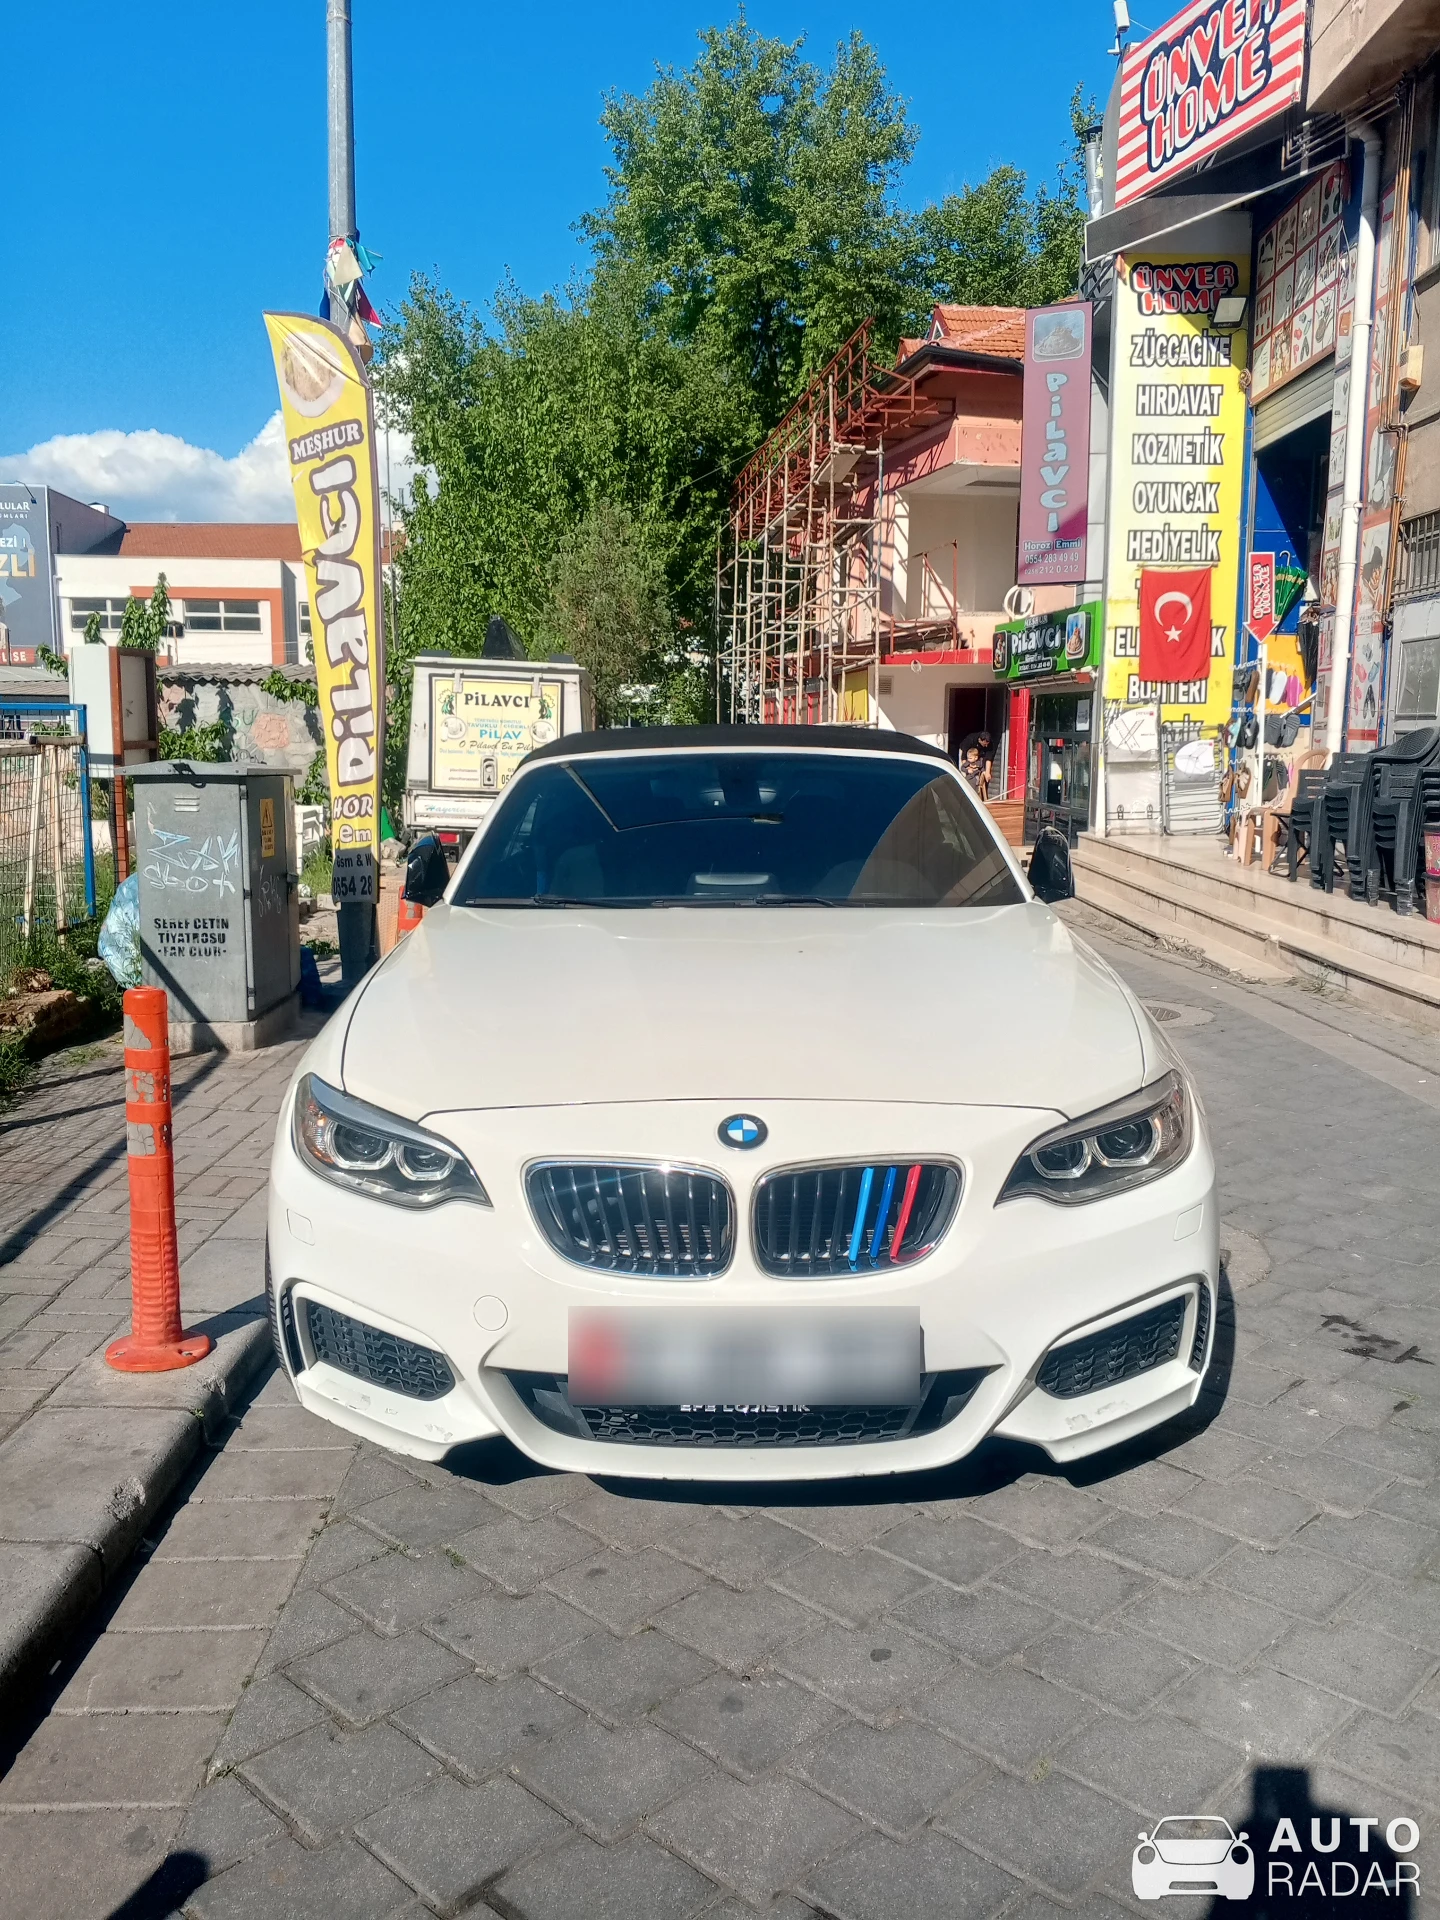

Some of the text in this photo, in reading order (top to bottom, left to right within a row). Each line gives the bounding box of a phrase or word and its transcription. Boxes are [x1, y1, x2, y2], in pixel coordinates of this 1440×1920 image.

[1151, 28, 1267, 169] HOME
[1132, 264, 1237, 291] ÜNVER
[1130, 328, 1231, 367] ZÜCCACİYE
[1136, 384, 1224, 417] HIRDAVAT
[290, 420, 363, 463] MEŞHUR
[1131, 426, 1226, 465] KOZMETİK
[1132, 481, 1222, 514] OYUNCAK
[1024, 542, 1051, 551] Horoz
[1025, 552, 1079, 564] 0554 283 49 49
[1127, 523, 1223, 562] HEDİYELİK
[1040, 566, 1054, 574] 212
[1056, 565, 1061, 573] 0
[1063, 565, 1079, 573] 212
[1252, 562, 1264, 620] ÜNVER
[1260, 563, 1271, 616] HOME
[356, 853, 363, 867] &
